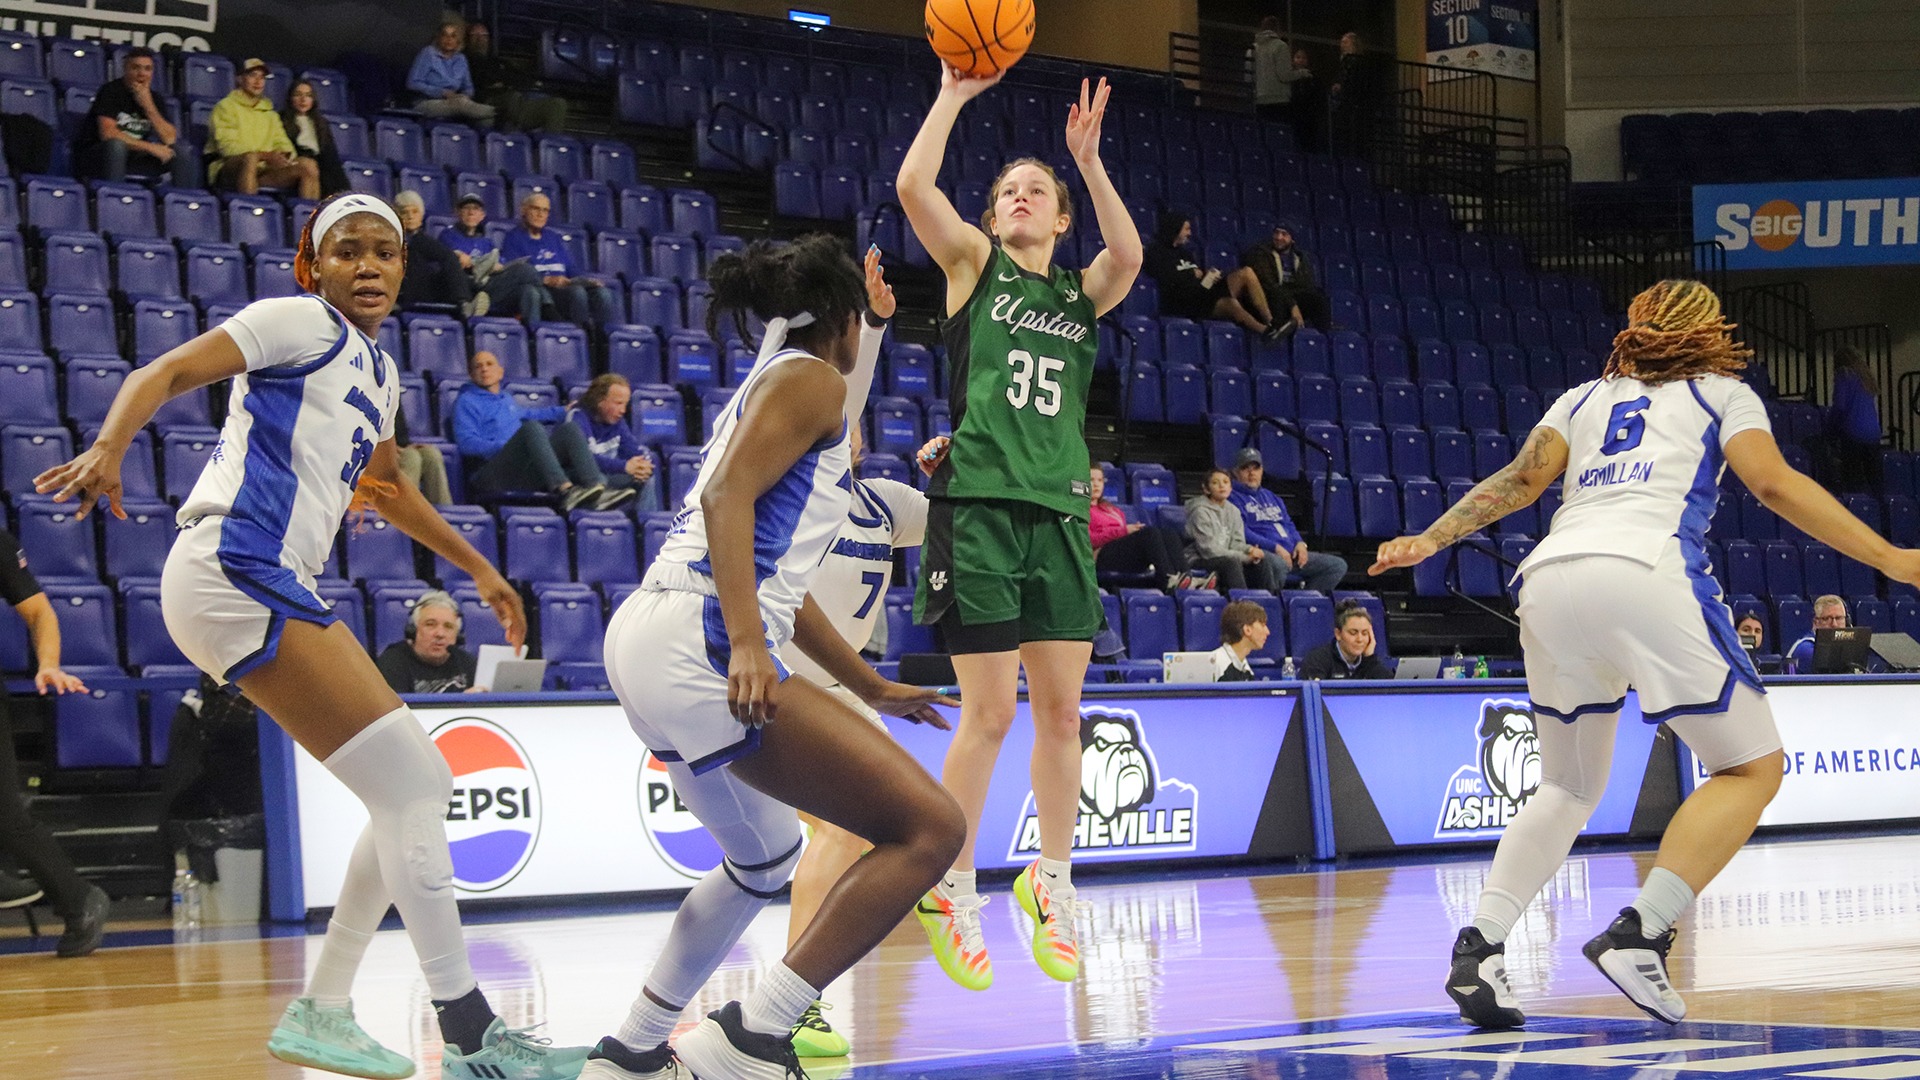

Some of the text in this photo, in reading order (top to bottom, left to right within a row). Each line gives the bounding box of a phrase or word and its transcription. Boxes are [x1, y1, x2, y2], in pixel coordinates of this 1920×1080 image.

[1433, 0, 1480, 16] SECTION
[1446, 14, 1468, 45] 10
[1751, 214, 1803, 237] BIG
[1006, 348, 1066, 417] 35
[1599, 395, 1652, 456] 6
[853, 571, 884, 619] 7
[1814, 747, 1920, 774] AMERICA
[1455, 777, 1482, 794] UNC
[446, 786, 531, 820] EPSI
[1016, 808, 1192, 852] AHEVILLE
